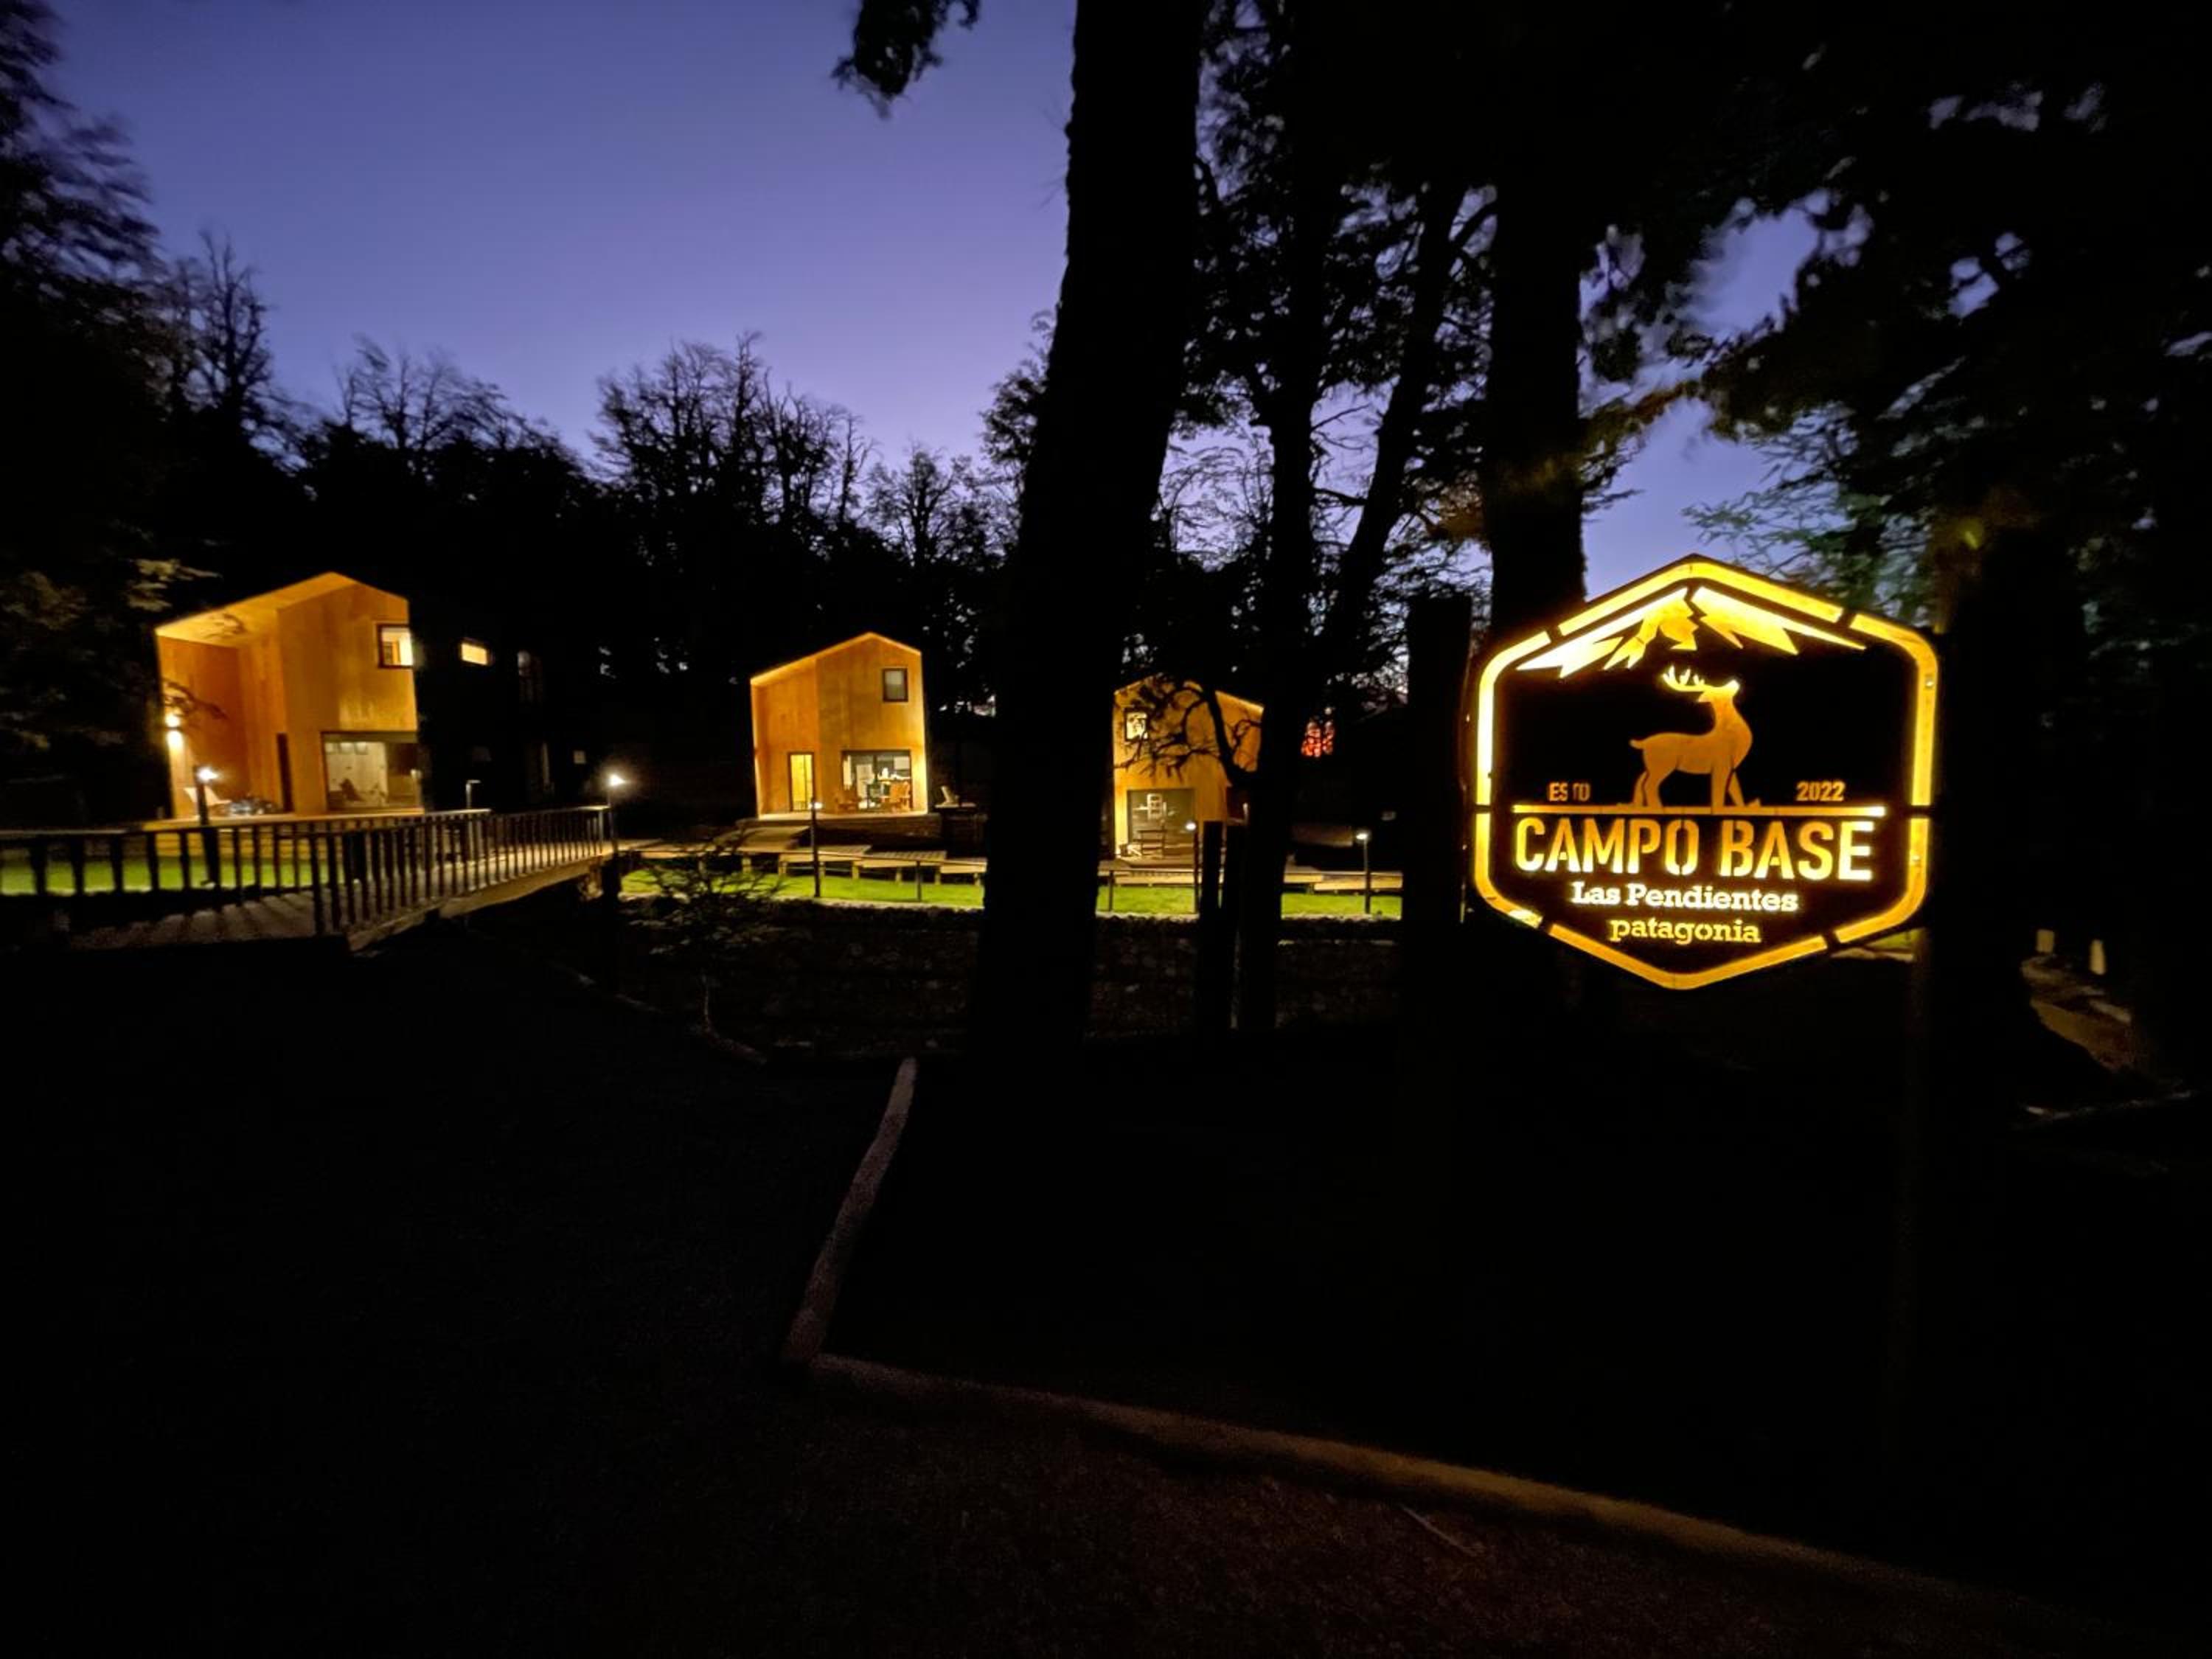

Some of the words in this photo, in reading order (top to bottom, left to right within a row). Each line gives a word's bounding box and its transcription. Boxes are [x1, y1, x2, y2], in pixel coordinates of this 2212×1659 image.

[1797, 781, 1846, 801] 2022
[1515, 817, 1699, 876] CAMPO
[1719, 820, 1874, 880] BASE
[1571, 881, 1621, 905] Las
[1627, 883, 1799, 912] Pendientes
[1609, 918, 1761, 945] patagonia
